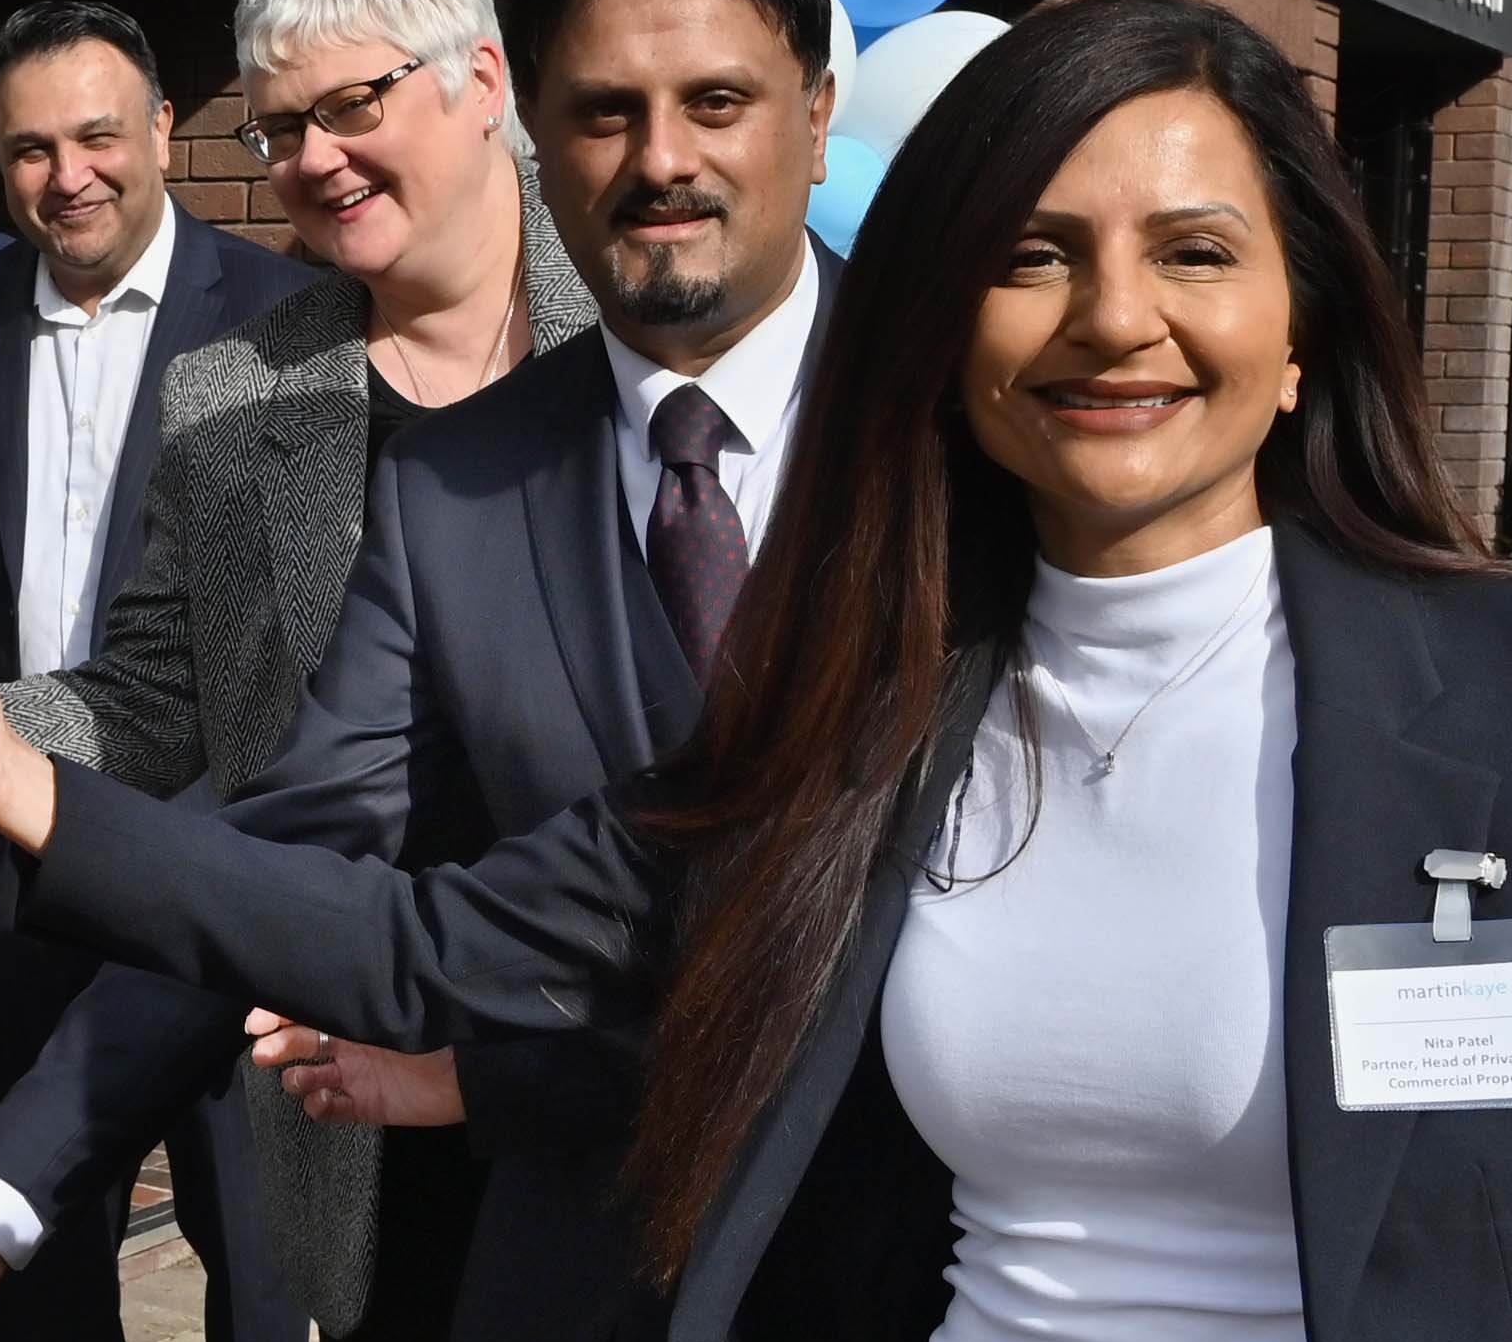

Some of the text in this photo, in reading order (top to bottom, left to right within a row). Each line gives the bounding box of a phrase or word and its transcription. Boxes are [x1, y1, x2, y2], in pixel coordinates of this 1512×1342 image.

[1397, 979, 1508, 1000] martinkaye
[1424, 1034, 1495, 1049] Nita Patel
[1361, 1059, 1418, 1071] Partner,
[1422, 1056, 1459, 1069] Head
[1463, 1054, 1478, 1067] of
[1388, 1075, 1473, 1090] Commercial
